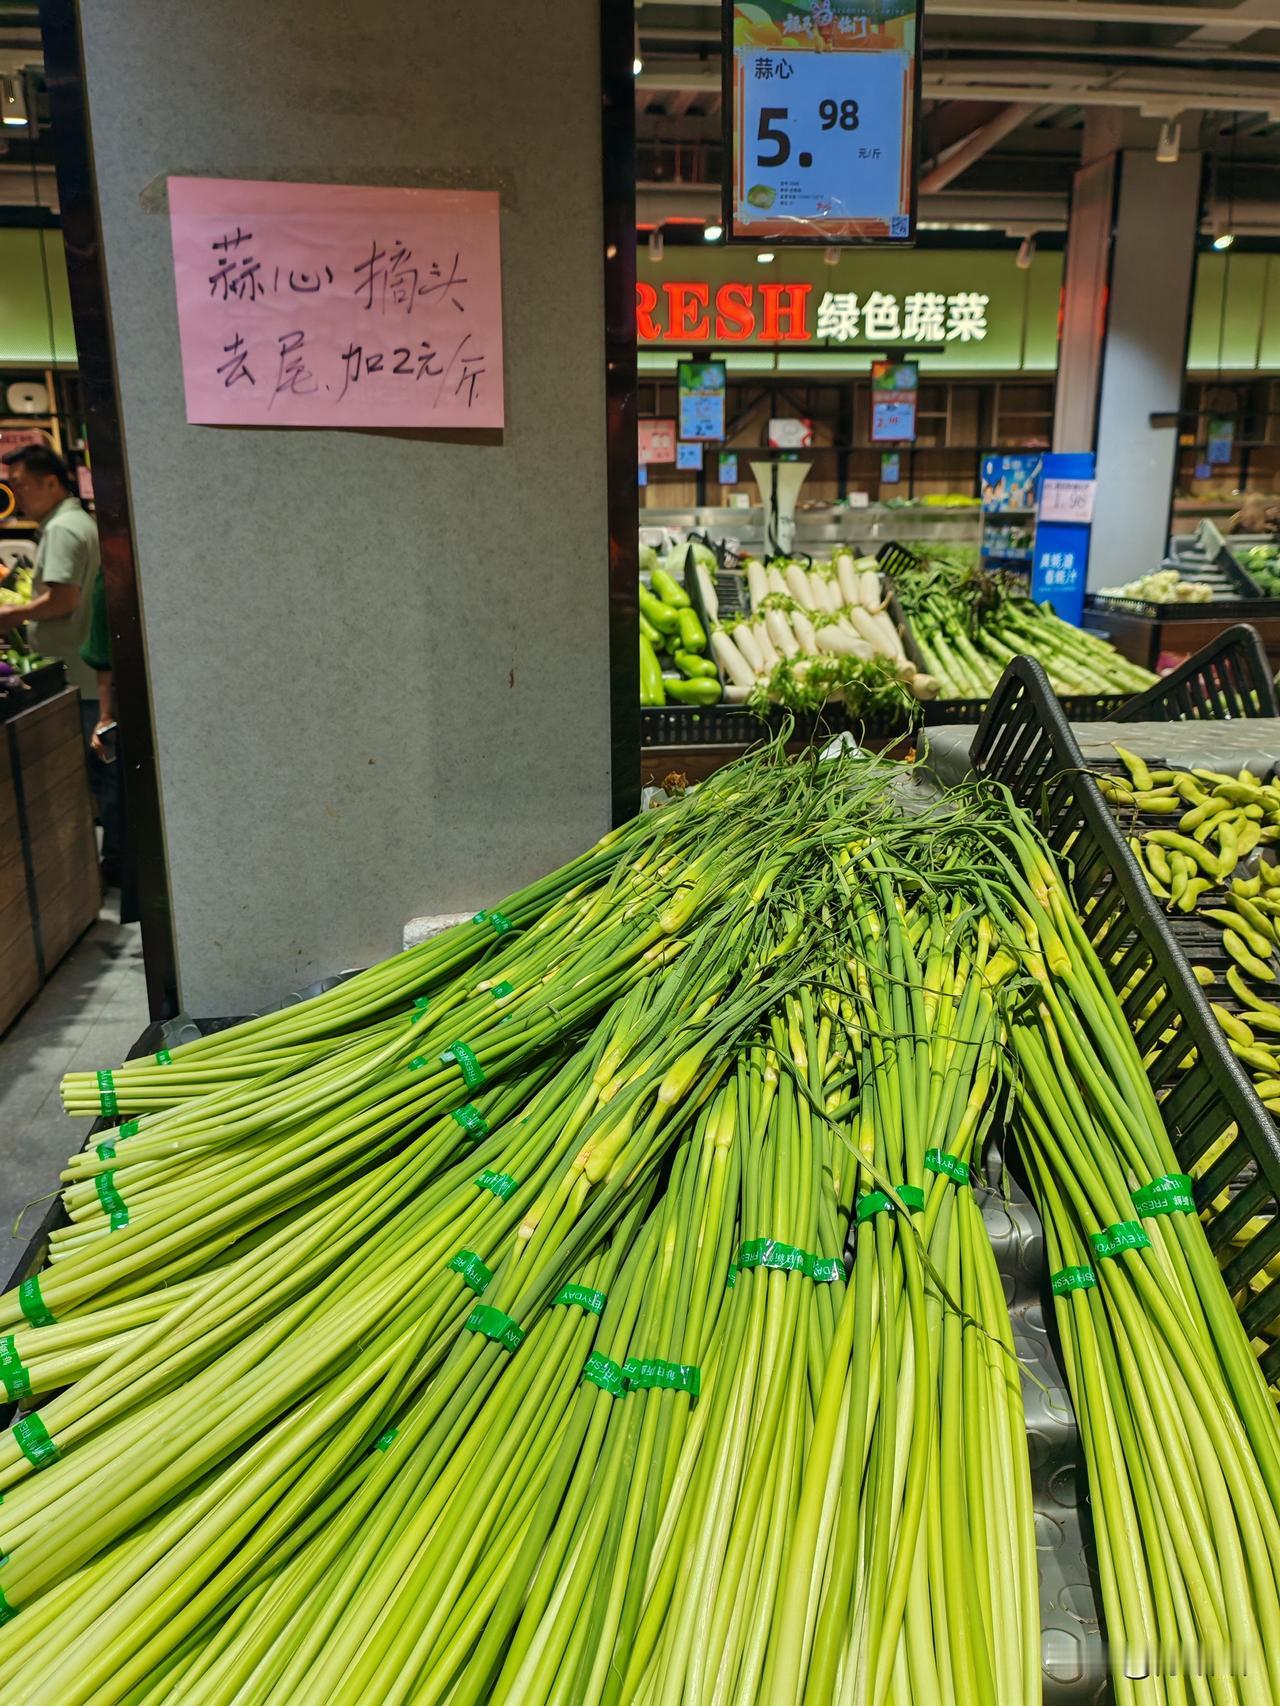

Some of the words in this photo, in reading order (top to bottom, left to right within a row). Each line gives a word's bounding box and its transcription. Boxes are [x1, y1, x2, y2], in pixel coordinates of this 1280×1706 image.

[755, 57, 795, 80] 蒜心
[818, 99, 859, 131] 98
[858, 148, 881, 160] 元/斤
[816, 291, 990, 342] 绿色蔬菜
